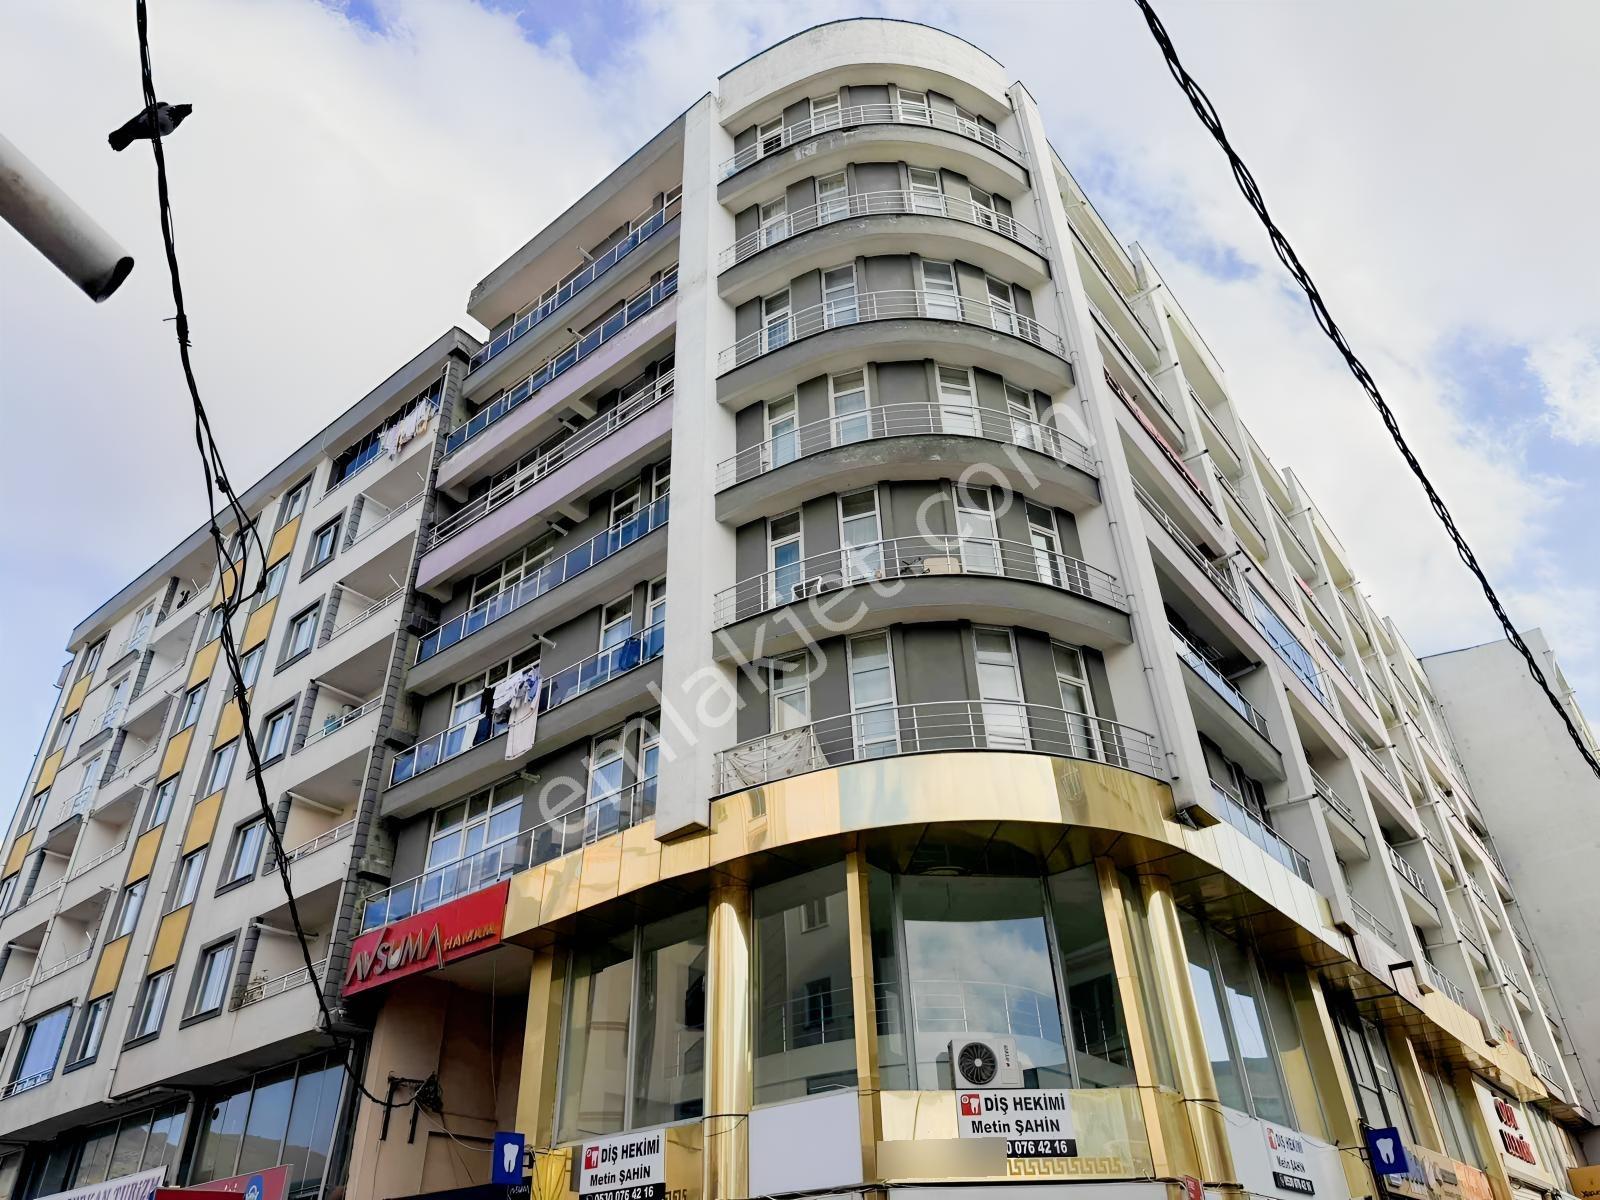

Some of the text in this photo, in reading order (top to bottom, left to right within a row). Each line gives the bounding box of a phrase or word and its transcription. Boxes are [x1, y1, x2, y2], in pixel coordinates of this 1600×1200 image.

[984, 1093, 1065, 1115] DİŞ HEKİMİ
[971, 1116, 1060, 1136] Metin ŞAHİN
[601, 1135, 660, 1165] DİŞ HEKİMİ
[1015, 1141, 1035, 1154] 076
[1038, 1141, 1051, 1154] 42
[1054, 1141, 1067, 1153] 16
[590, 1164, 651, 1187] Metin ŞAHİN
[615, 1190, 630, 1200] 076
[632, 1188, 642, 1199] 42
[644, 1186, 654, 1197] 16
